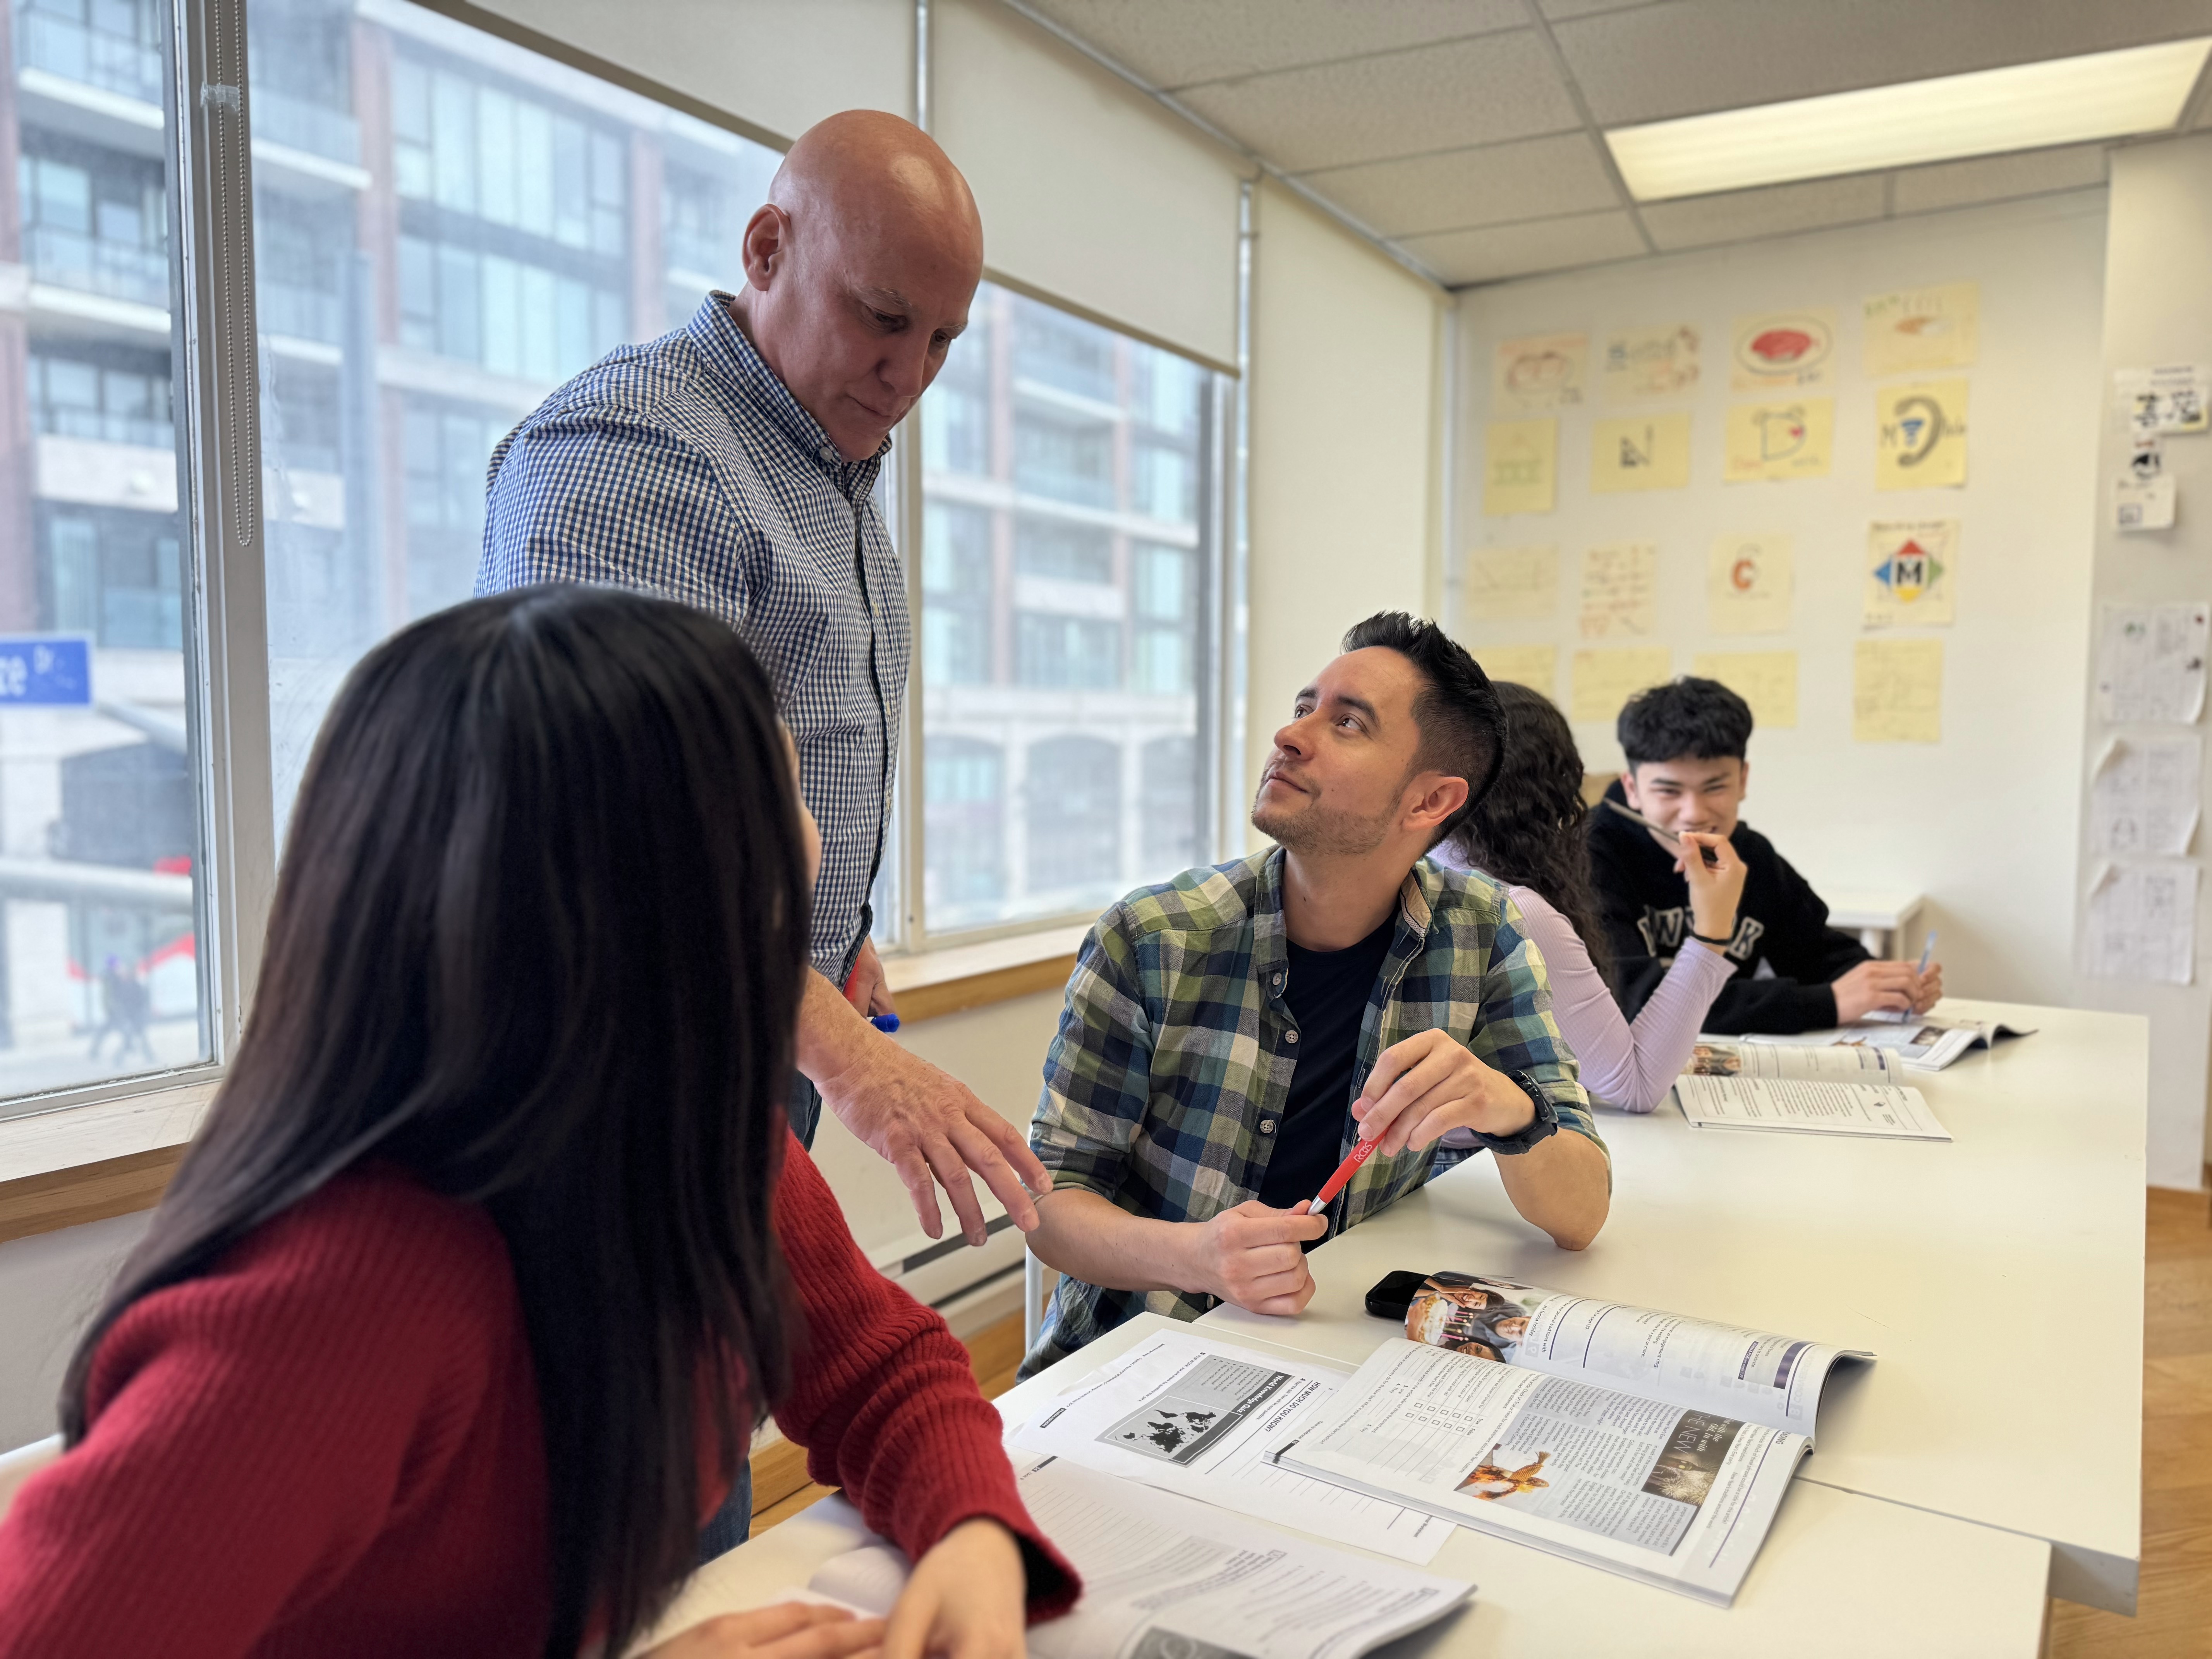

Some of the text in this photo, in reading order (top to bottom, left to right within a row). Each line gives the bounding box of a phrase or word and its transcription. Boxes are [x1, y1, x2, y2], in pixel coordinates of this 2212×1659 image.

[1540, 1343, 1549, 1353] with
[1653, 1358, 1661, 1369] ring.
[1267, 1374, 1285, 1386] World
[1307, 1382, 1322, 1391] HOW
[1245, 1385, 1273, 1405] Knowledge
[1294, 1390, 1313, 1403] MUCH
[1235, 1403, 1252, 1414] Quiz
[1278, 1407, 1293, 1417] YOU
[1262, 1416, 1284, 1432] KNOW?
[1705, 1422, 1719, 1432] Old,
[1716, 1424, 1729, 1433] with
[1670, 1412, 1711, 1454] THE NEW
[1711, 1433, 1723, 1442] the
[1695, 1439, 1710, 1452] with
[1738, 1477, 1748, 1487] could
